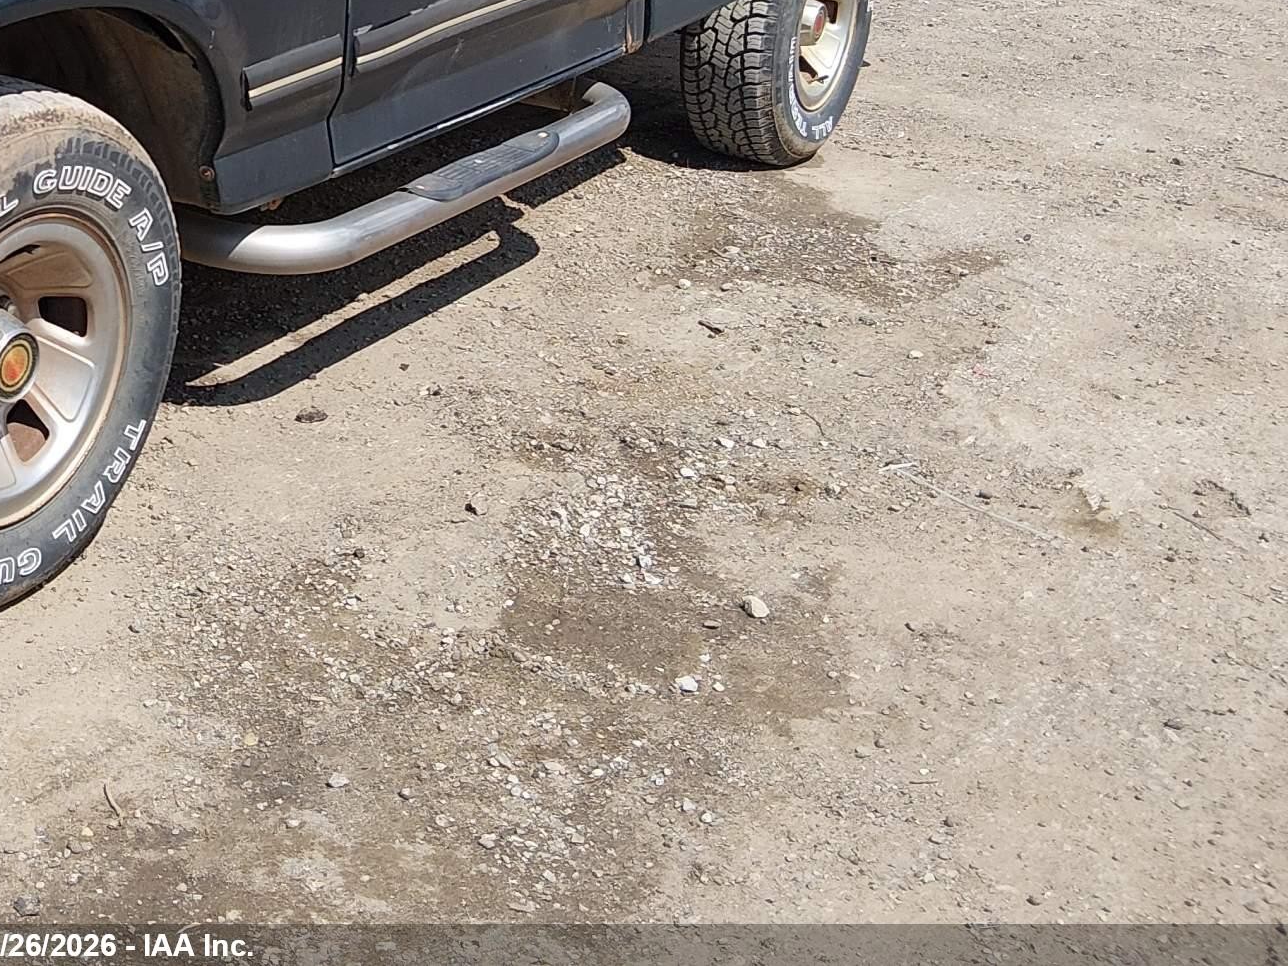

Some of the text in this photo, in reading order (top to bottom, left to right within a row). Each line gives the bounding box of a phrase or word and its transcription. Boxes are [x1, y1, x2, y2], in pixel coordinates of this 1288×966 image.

[812, 115, 834, 140] ALL
[33, 165, 132, 210] GUIDE
[128, 207, 170, 286] A/P
[51, 419, 147, 543] TRAIL
